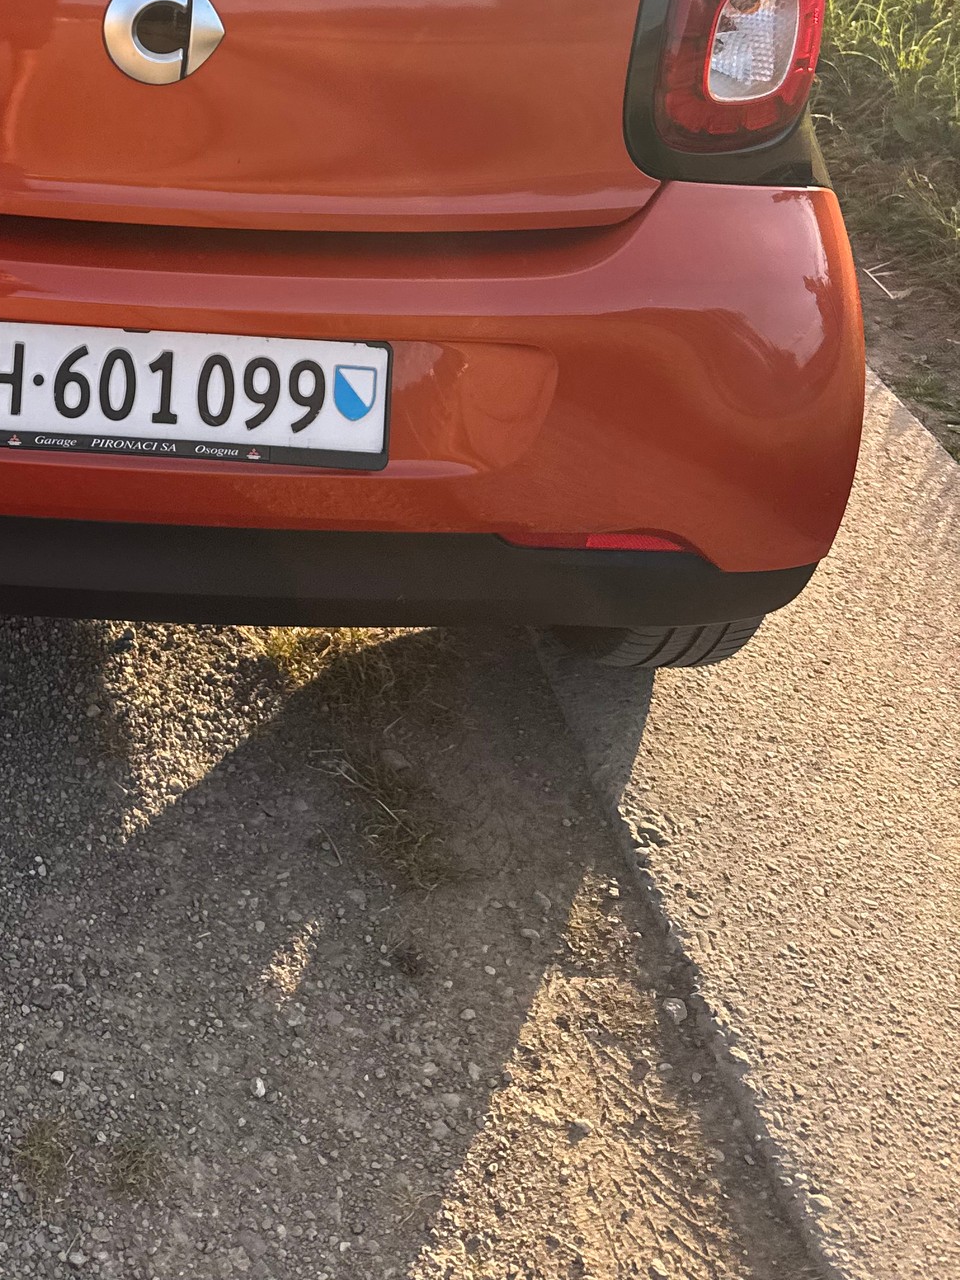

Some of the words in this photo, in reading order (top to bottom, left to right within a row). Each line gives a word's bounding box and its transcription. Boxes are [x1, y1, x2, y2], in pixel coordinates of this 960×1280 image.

[34, 435, 77, 448] Garage
[91, 438, 158, 452] PIRONACI
[160, 442, 177, 453] SA
[194, 444, 239, 458] Osogna
